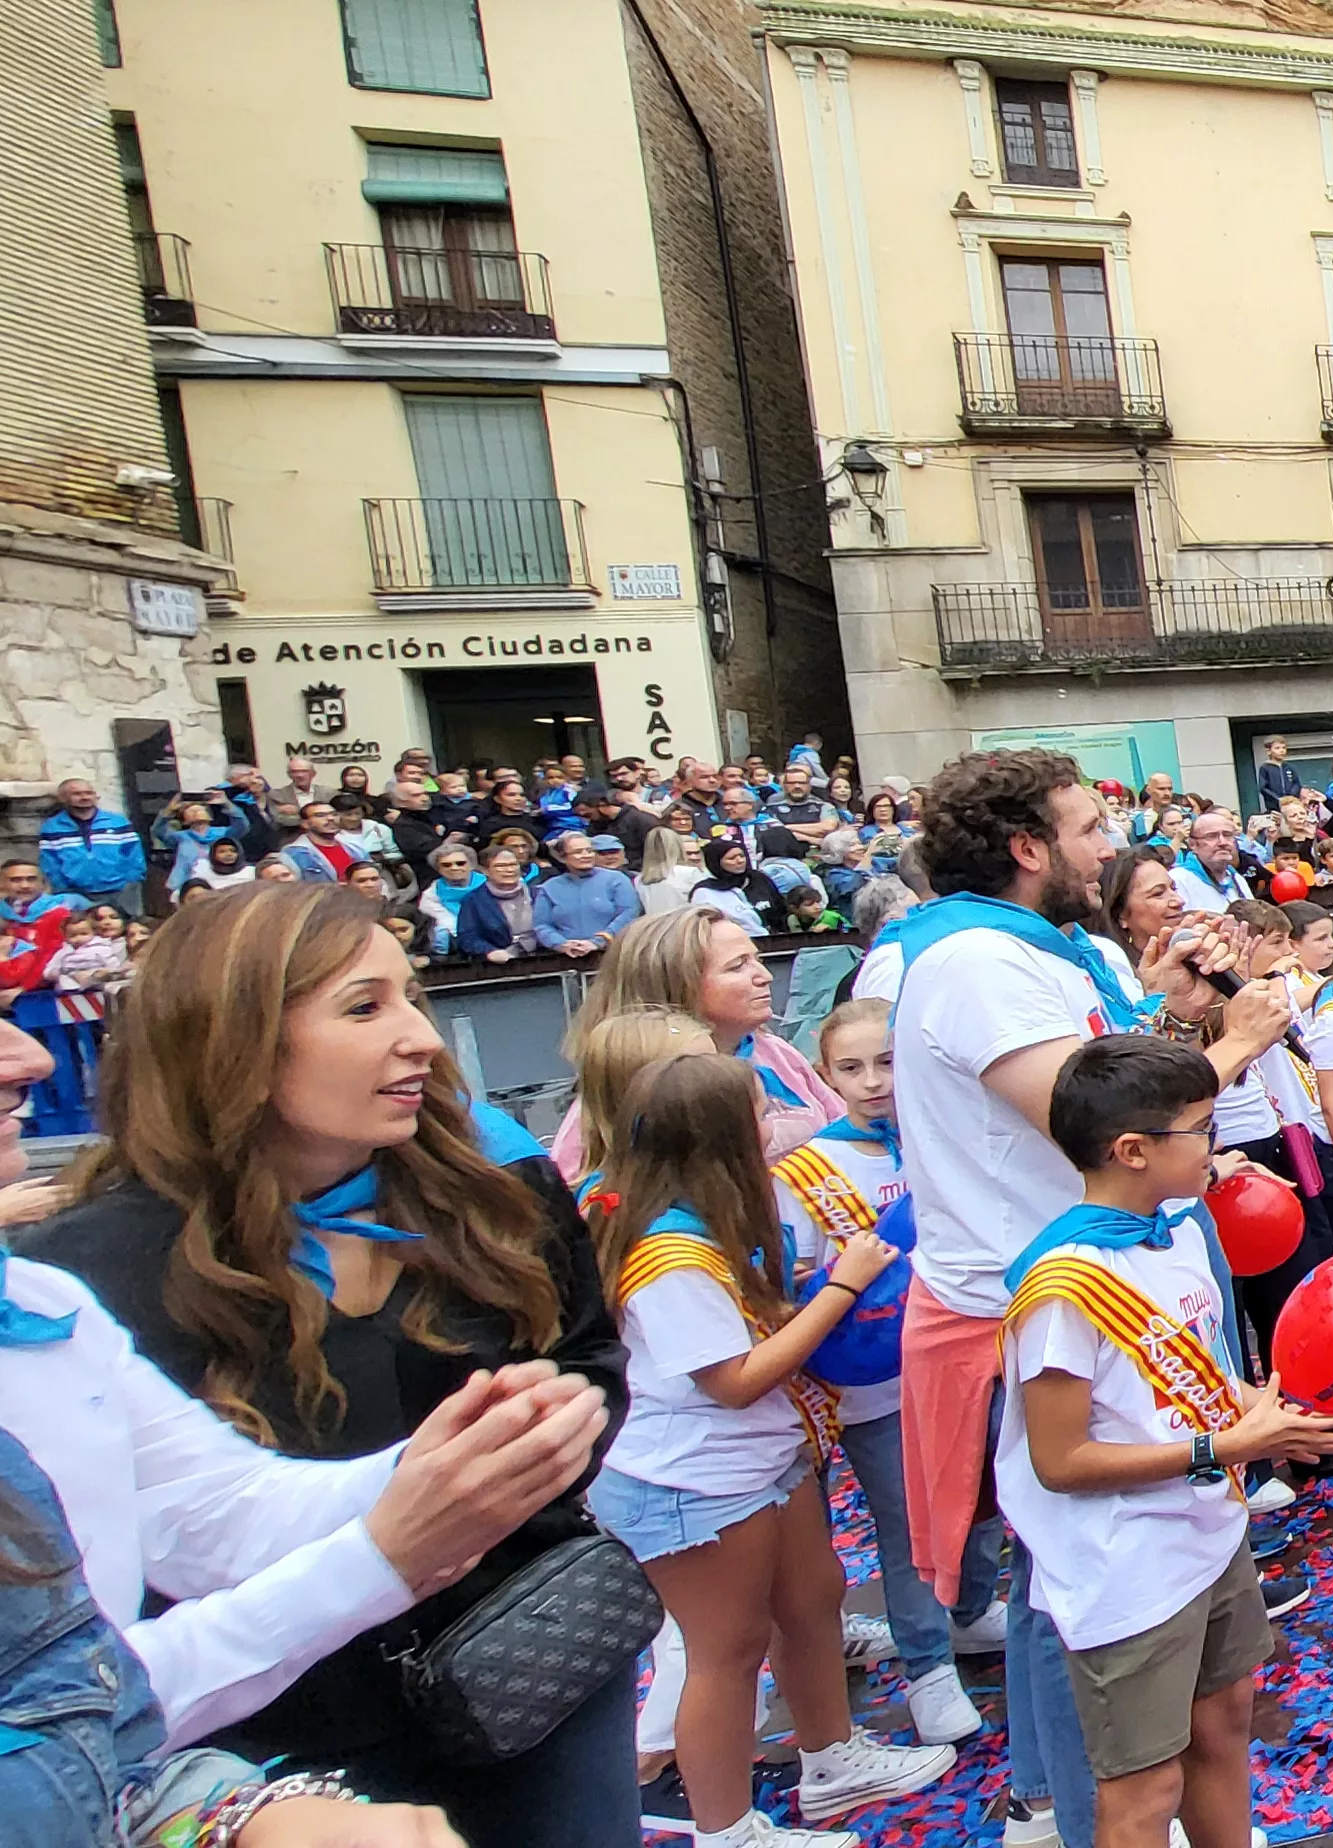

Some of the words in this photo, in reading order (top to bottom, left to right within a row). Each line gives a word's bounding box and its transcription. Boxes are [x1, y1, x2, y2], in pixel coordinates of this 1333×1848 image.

[635, 569, 673, 581] CALLE
[621, 582, 673, 595] MAYOR
[212, 643, 257, 665] de
[275, 635, 447, 663] Atención
[462, 632, 652, 656] Ciudadana
[644, 683, 674, 760] SAC
[285, 738, 381, 757] Monzón
